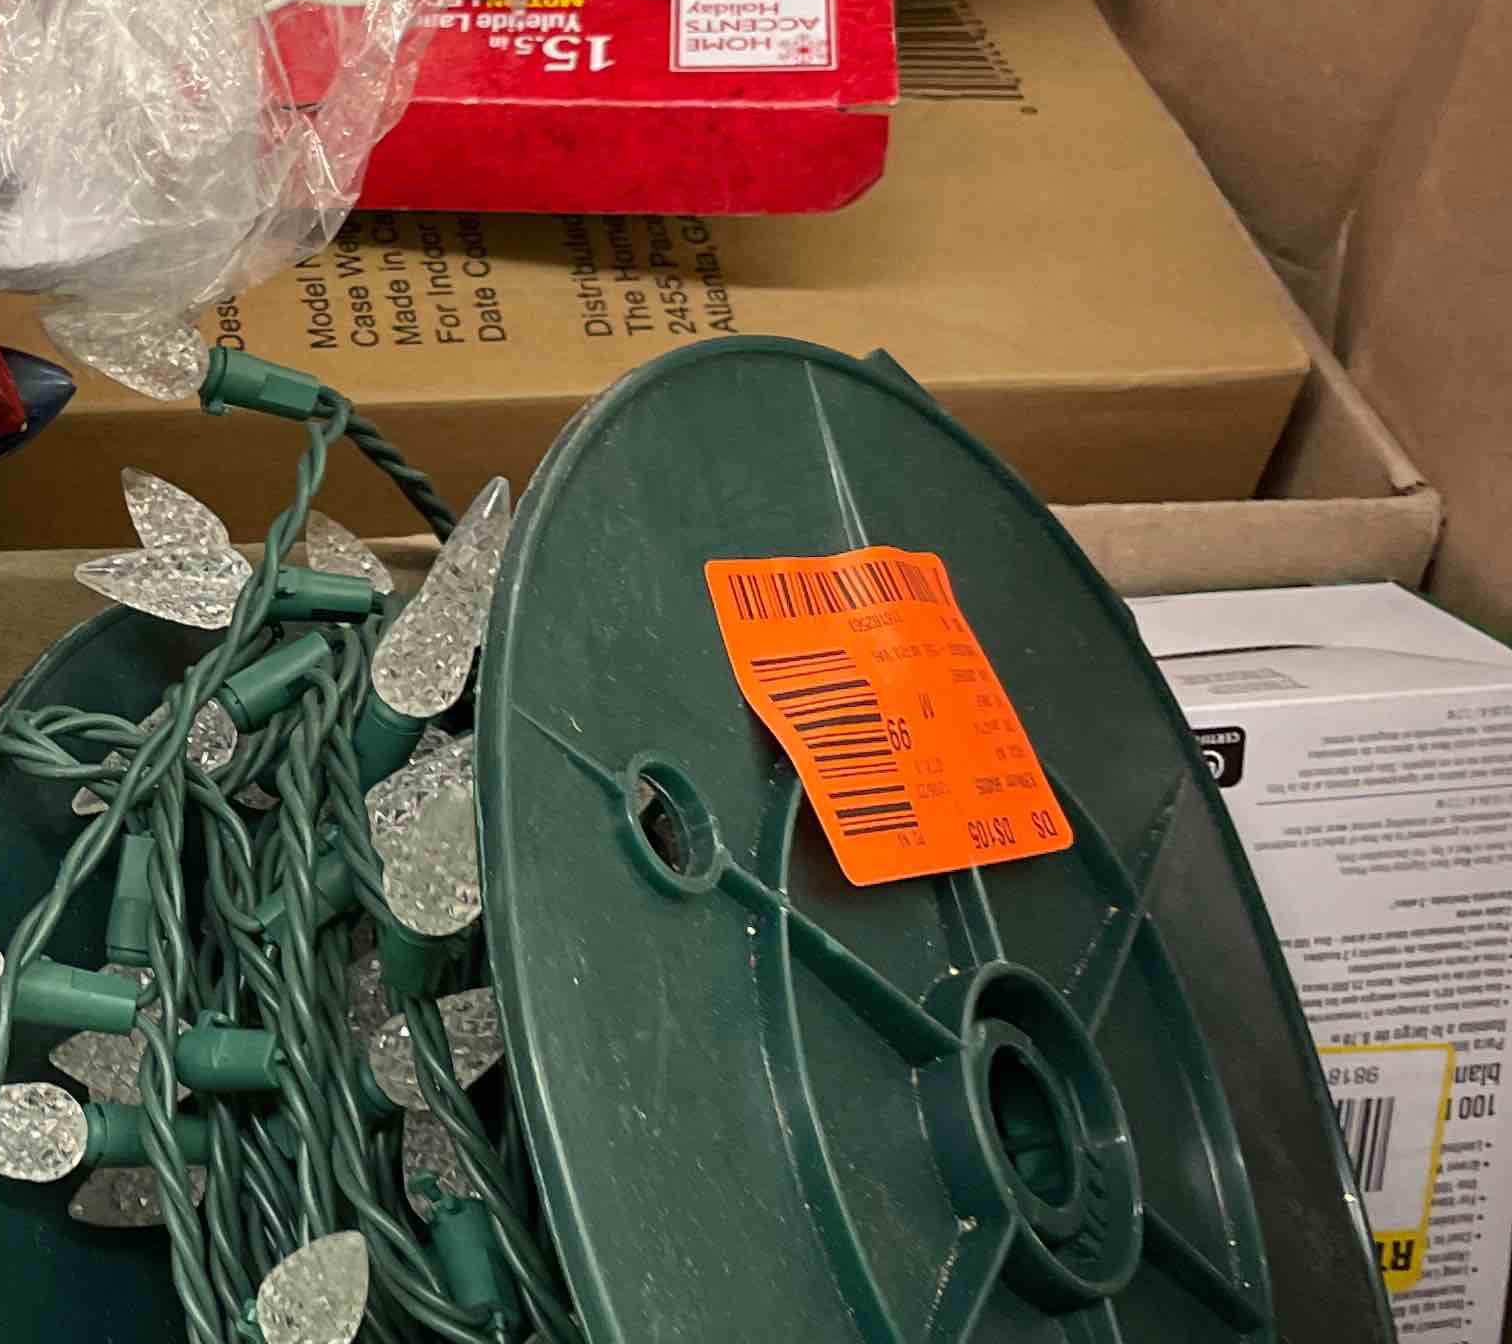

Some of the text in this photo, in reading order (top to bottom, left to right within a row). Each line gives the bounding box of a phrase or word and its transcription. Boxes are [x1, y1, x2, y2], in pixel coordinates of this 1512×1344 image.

[686, 1, 779, 15] Holiday
[686, 18, 821, 32] ACCENTS
[489, 34, 616, 72] 15.5 in
[688, 38, 772, 52] HOME
[377, 251, 406, 272] in
[296, 277, 337, 350] Model
[347, 286, 379, 348] Case
[385, 279, 423, 346] Made
[473, 287, 506, 343] Date
[624, 291, 655, 337] The
[655, 277, 697, 336] 2455
[435, 303, 464, 344] For
[1032, 811, 1057, 839] DS
[1373, 1029, 1389, 1041] de
[1393, 1025, 1428, 1040] largo
[1473, 1037, 1504, 1050] Para
[1458, 1093, 1496, 1119] 100
